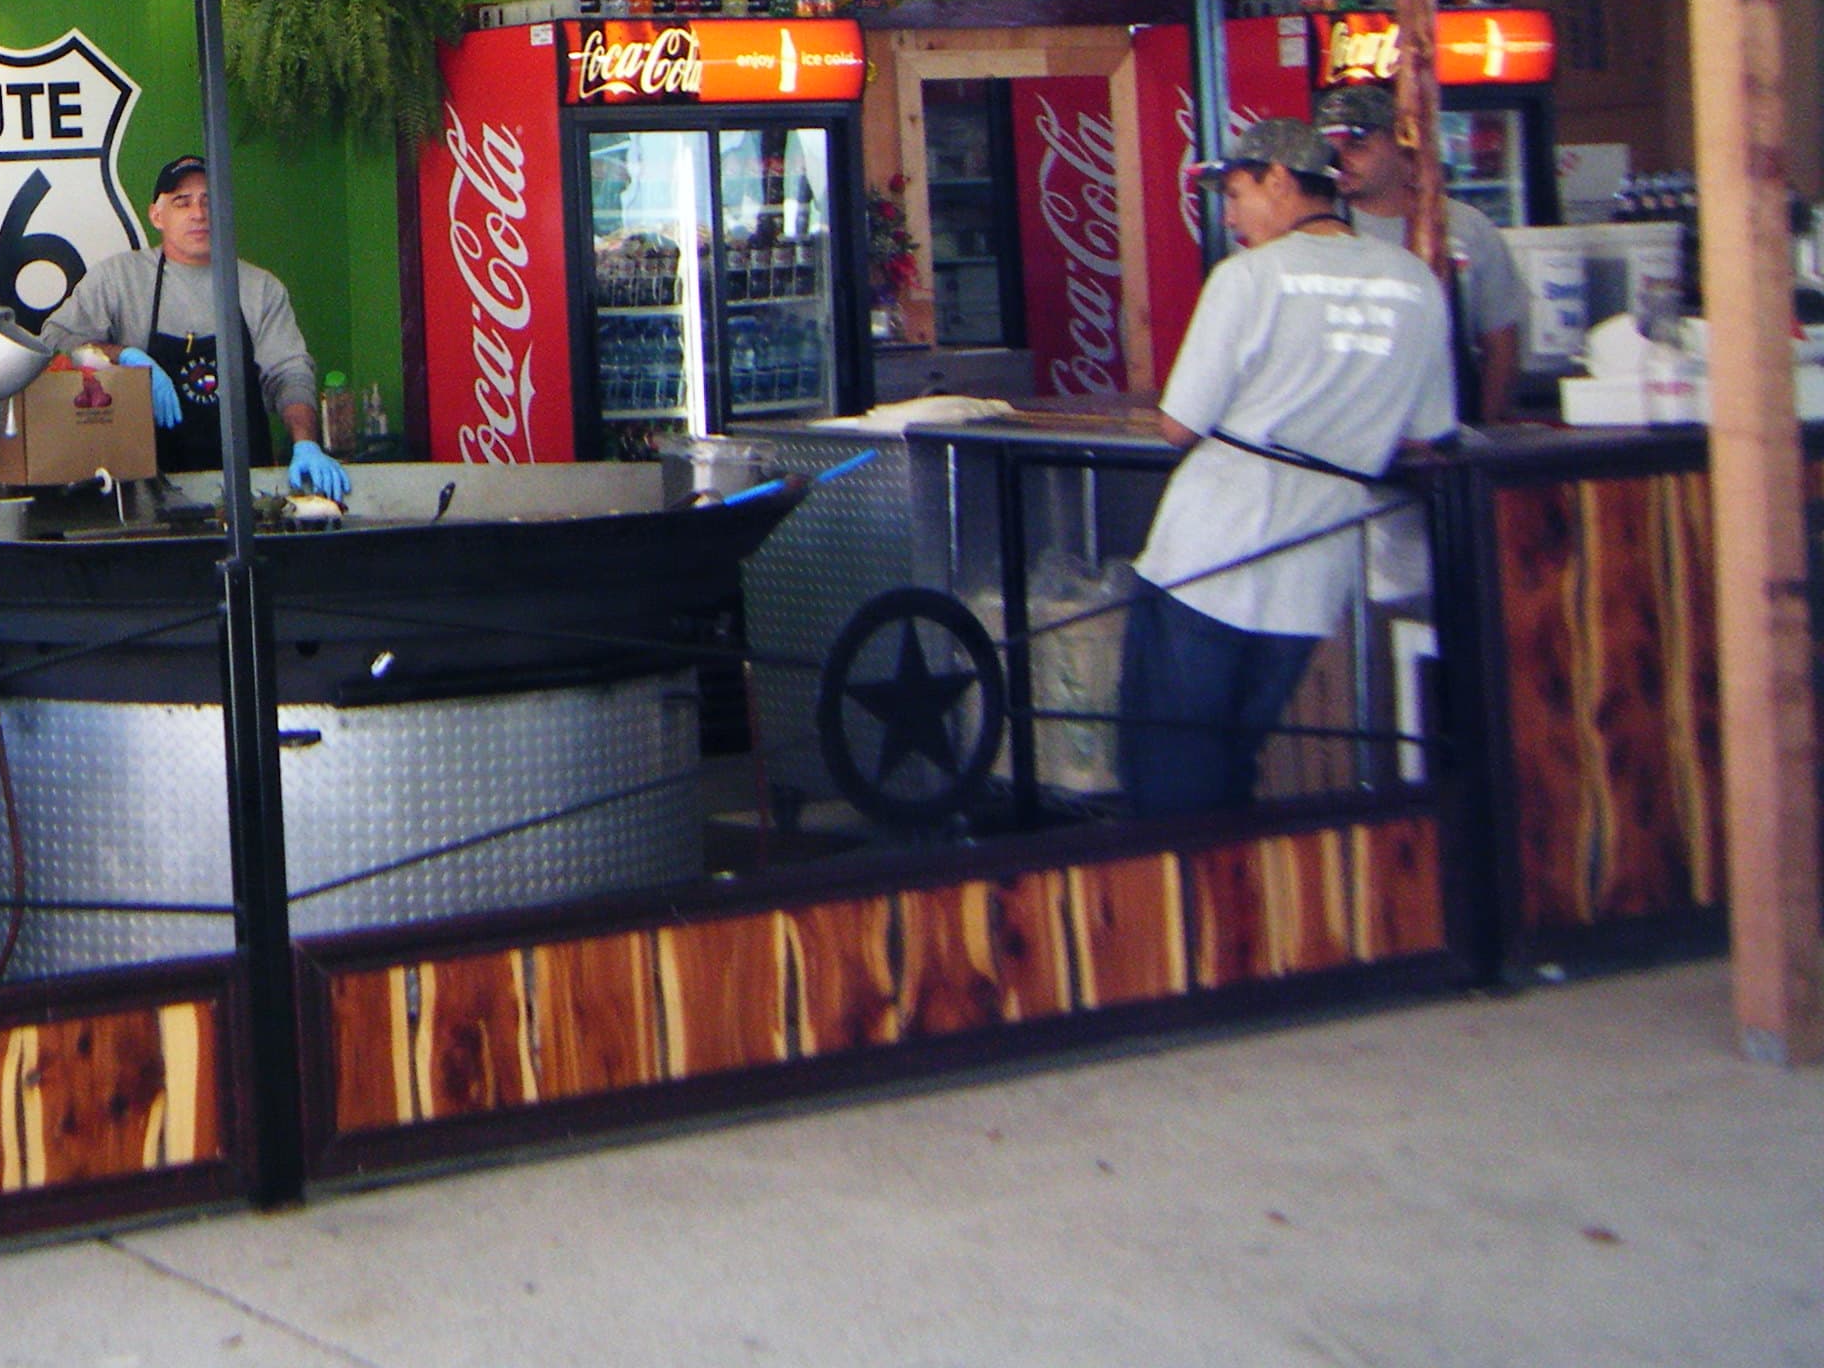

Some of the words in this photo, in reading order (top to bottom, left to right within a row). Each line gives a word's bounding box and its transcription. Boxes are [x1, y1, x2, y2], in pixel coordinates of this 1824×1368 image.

[579, 27, 703, 99] Coca-Cola
[735, 52, 776, 69] enjoy
[801, 51, 823, 66] ice
